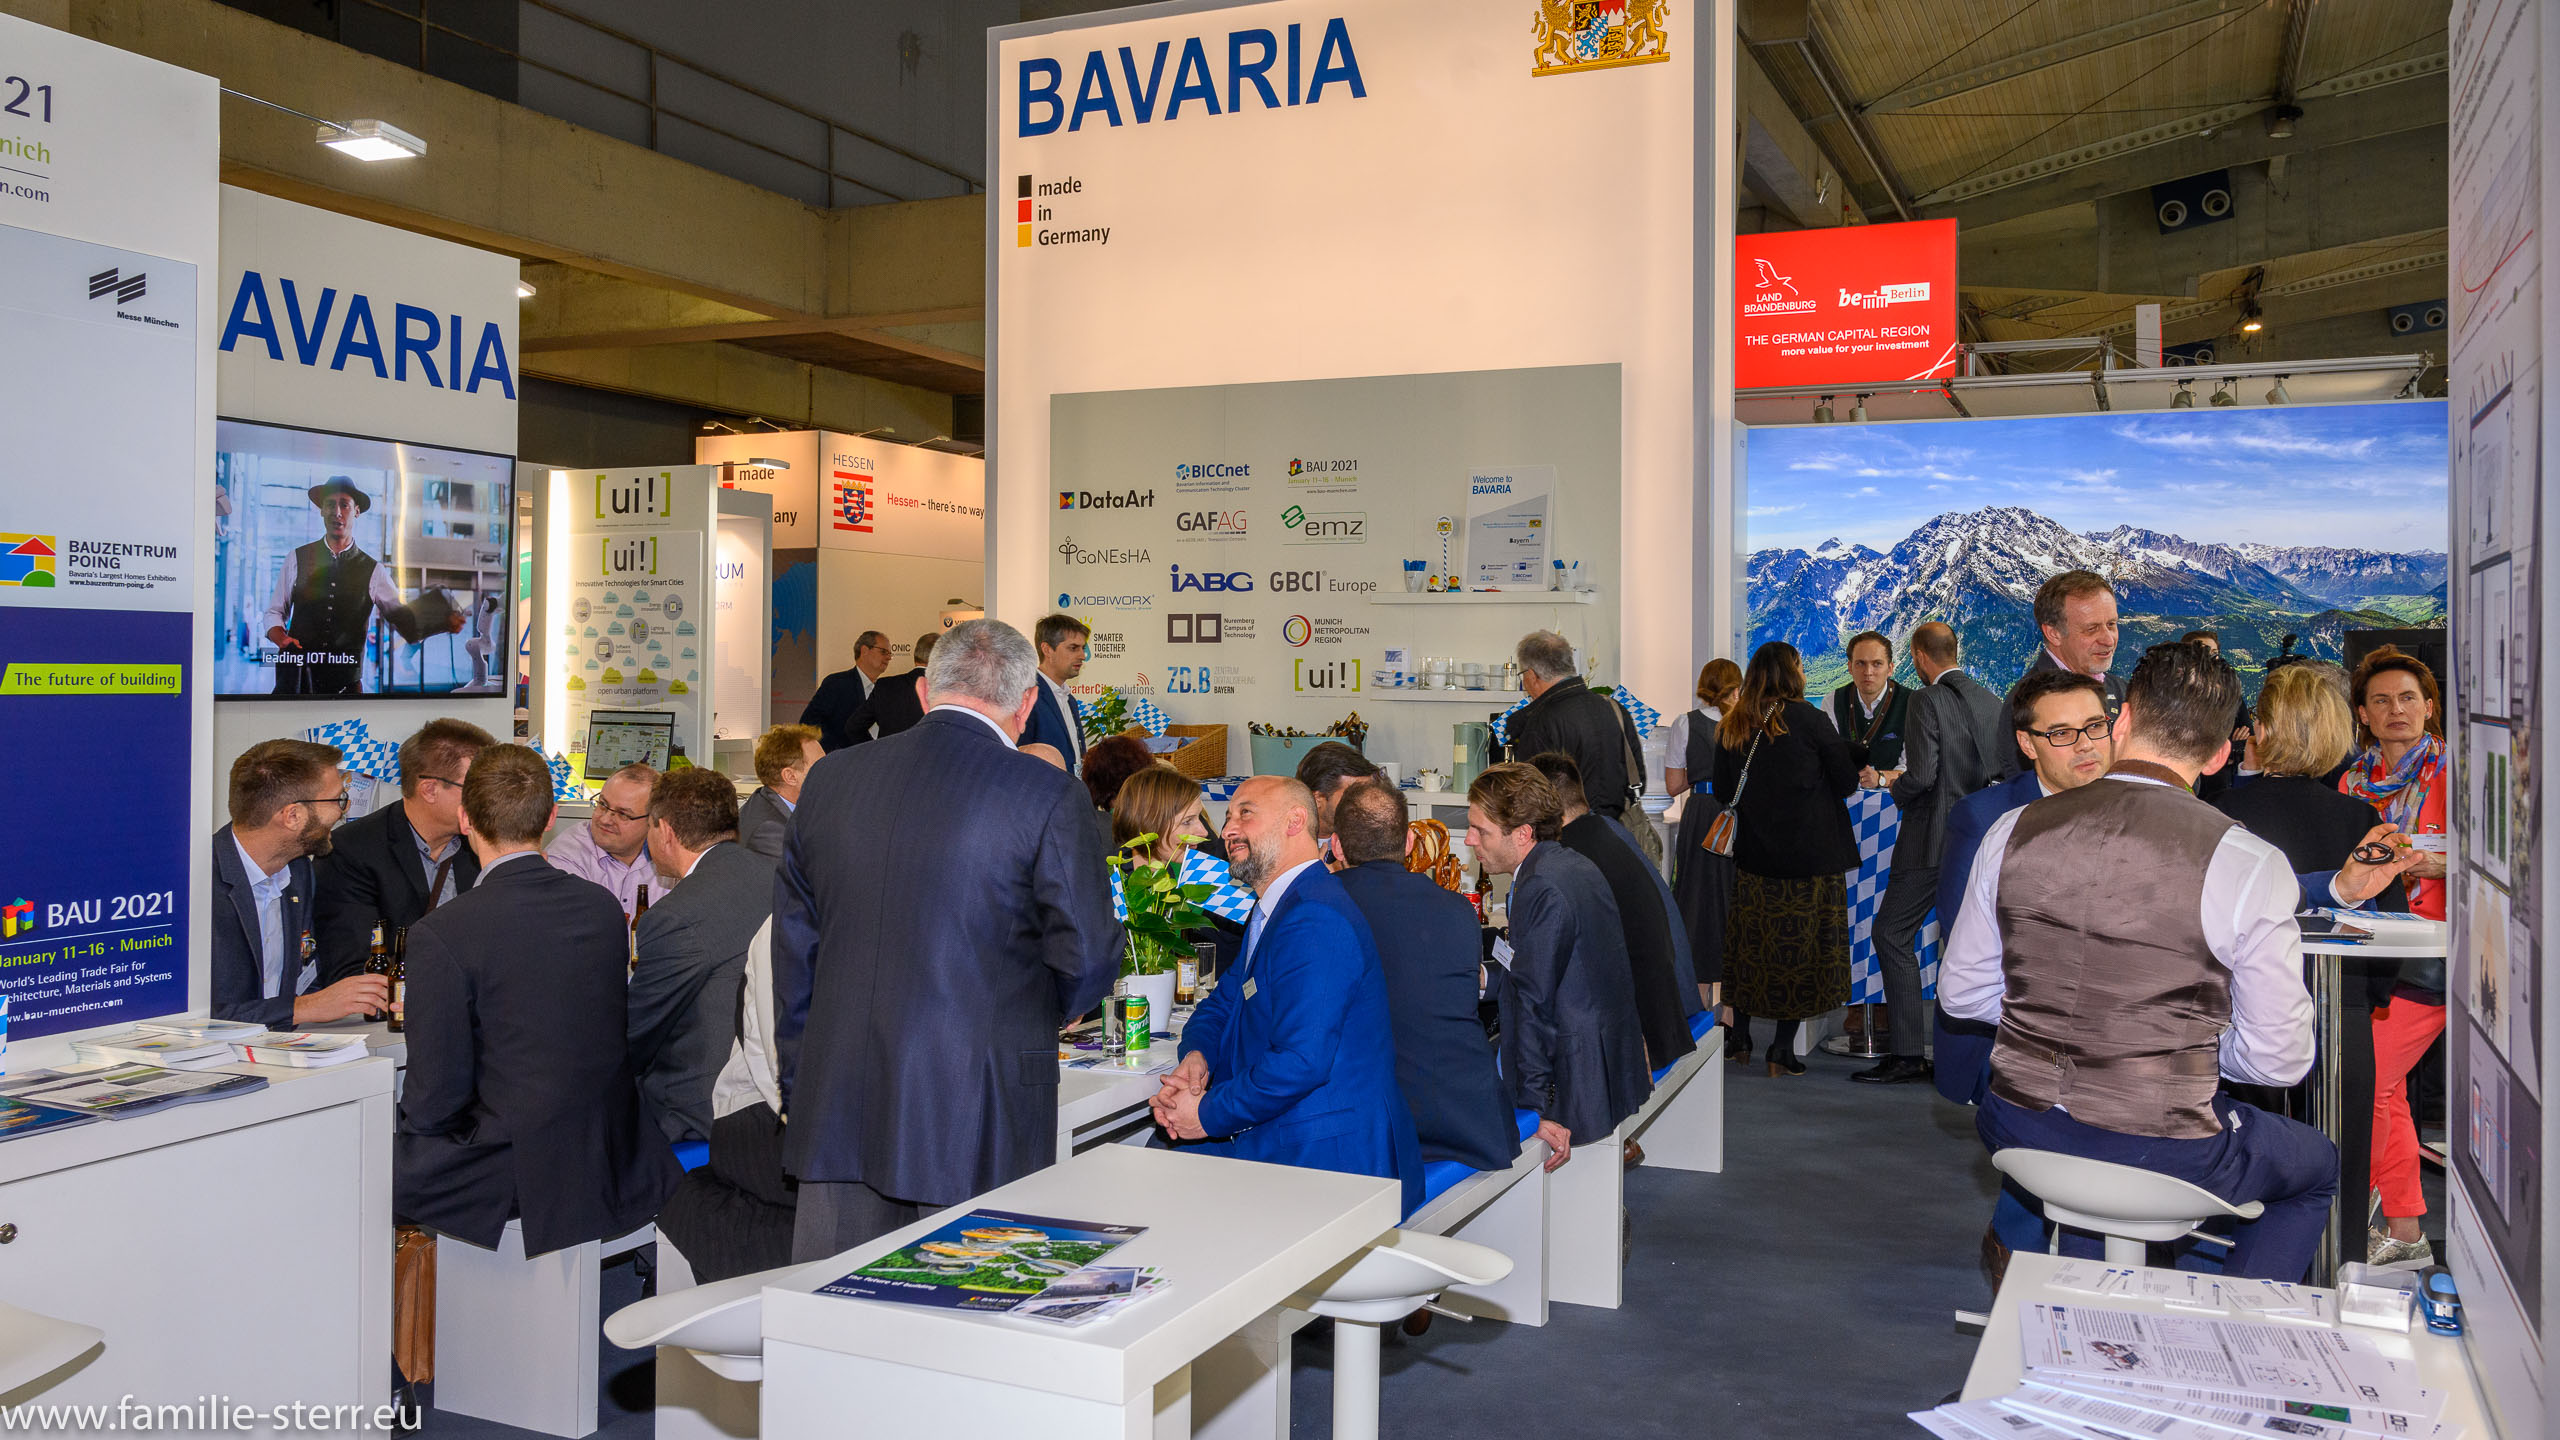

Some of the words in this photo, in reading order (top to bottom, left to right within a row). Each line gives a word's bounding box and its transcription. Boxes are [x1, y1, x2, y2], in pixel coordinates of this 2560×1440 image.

[1018, 17, 1367, 138] BAVARIA
[1039, 176, 1082, 196] made
[1038, 204, 1052, 221] in
[1038, 228, 1110, 246] Germany
[1756, 293, 1782, 302] LAND
[1891, 287, 1925, 299] Berlin
[1744, 300, 1816, 313] BRANDENBURG
[117, 311, 142, 322] Messe
[144, 316, 179, 328] München
[219, 270, 517, 400] AVARIA
[1745, 335, 1769, 346] THE
[1772, 332, 1824, 345] GERMAN
[1827, 328, 1878, 341] CAPITAL
[1881, 325, 1930, 338] REGION
[1781, 348, 1805, 356] more
[1807, 345, 1833, 355] value
[1835, 344, 1849, 352] for
[1851, 344, 1873, 354] your
[1875, 340, 1930, 351] investment
[833, 453, 874, 471] HESSEN
[1306, 461, 1328, 473] BAU
[1330, 459, 1358, 472] 2021
[739, 467, 775, 481] made
[1191, 464, 1251, 479] BICCnet
[1472, 475, 1505, 484] Welcome
[1506, 475, 1513, 483] to
[1288, 477, 1311, 485] January
[1472, 484, 1512, 494] BAVARIA
[887, 493, 919, 508] Hessen
[958, 505, 968, 515] no
[969, 507, 984, 520] way
[1079, 489, 1154, 509] DataArt
[1176, 510, 1247, 531] GAFAG
[1305, 520, 1363, 536] emz
[69, 540, 177, 558] BAUZENTRUM
[69, 555, 121, 569] POING
[68, 570, 98, 579] Bavaria's
[99, 572, 123, 581] Largest
[124, 573, 146, 581] Homes
[147, 574, 177, 582] Exhibition
[715, 563, 744, 579] UM
[69, 579, 154, 589] www.bauzentrum-poing.de
[576, 580, 604, 588] Innovative
[605, 580, 640, 588] Technologies
[641, 579, 649, 587] for
[650, 579, 668, 587] Smart
[668, 578, 684, 586] Cities
[1329, 579, 1377, 595] Europe
[1074, 595, 1152, 606] MOBIWORX
[1315, 618, 1343, 626] MUNICH
[1093, 633, 1124, 642] SMARTER
[1315, 627, 1370, 635] METROPOLITAN
[1094, 643, 1126, 652] TOGETHER
[1315, 636, 1342, 644] REGION
[262, 651, 304, 667] leading
[306, 651, 326, 664] IOT
[328, 652, 358, 665] hubs.
[15, 672, 42, 686] The
[47, 672, 95, 687] future
[100, 671, 116, 686] of
[120, 672, 176, 689] building
[597, 689, 614, 697] open
[632, 687, 659, 697] platform
[1213, 686, 1235, 694] BAYERN
[48, 899, 101, 928] BAU
[110, 890, 173, 921] 2021
[120, 934, 173, 953] Munich
[38, 968, 78, 985] Leading
[81, 965, 108, 978] Trade
[110, 963, 129, 974] Fair
[131, 960, 146, 971] for
[65, 979, 112, 995] Materials
[113, 976, 132, 988] and
[134, 971, 173, 985] Systems
